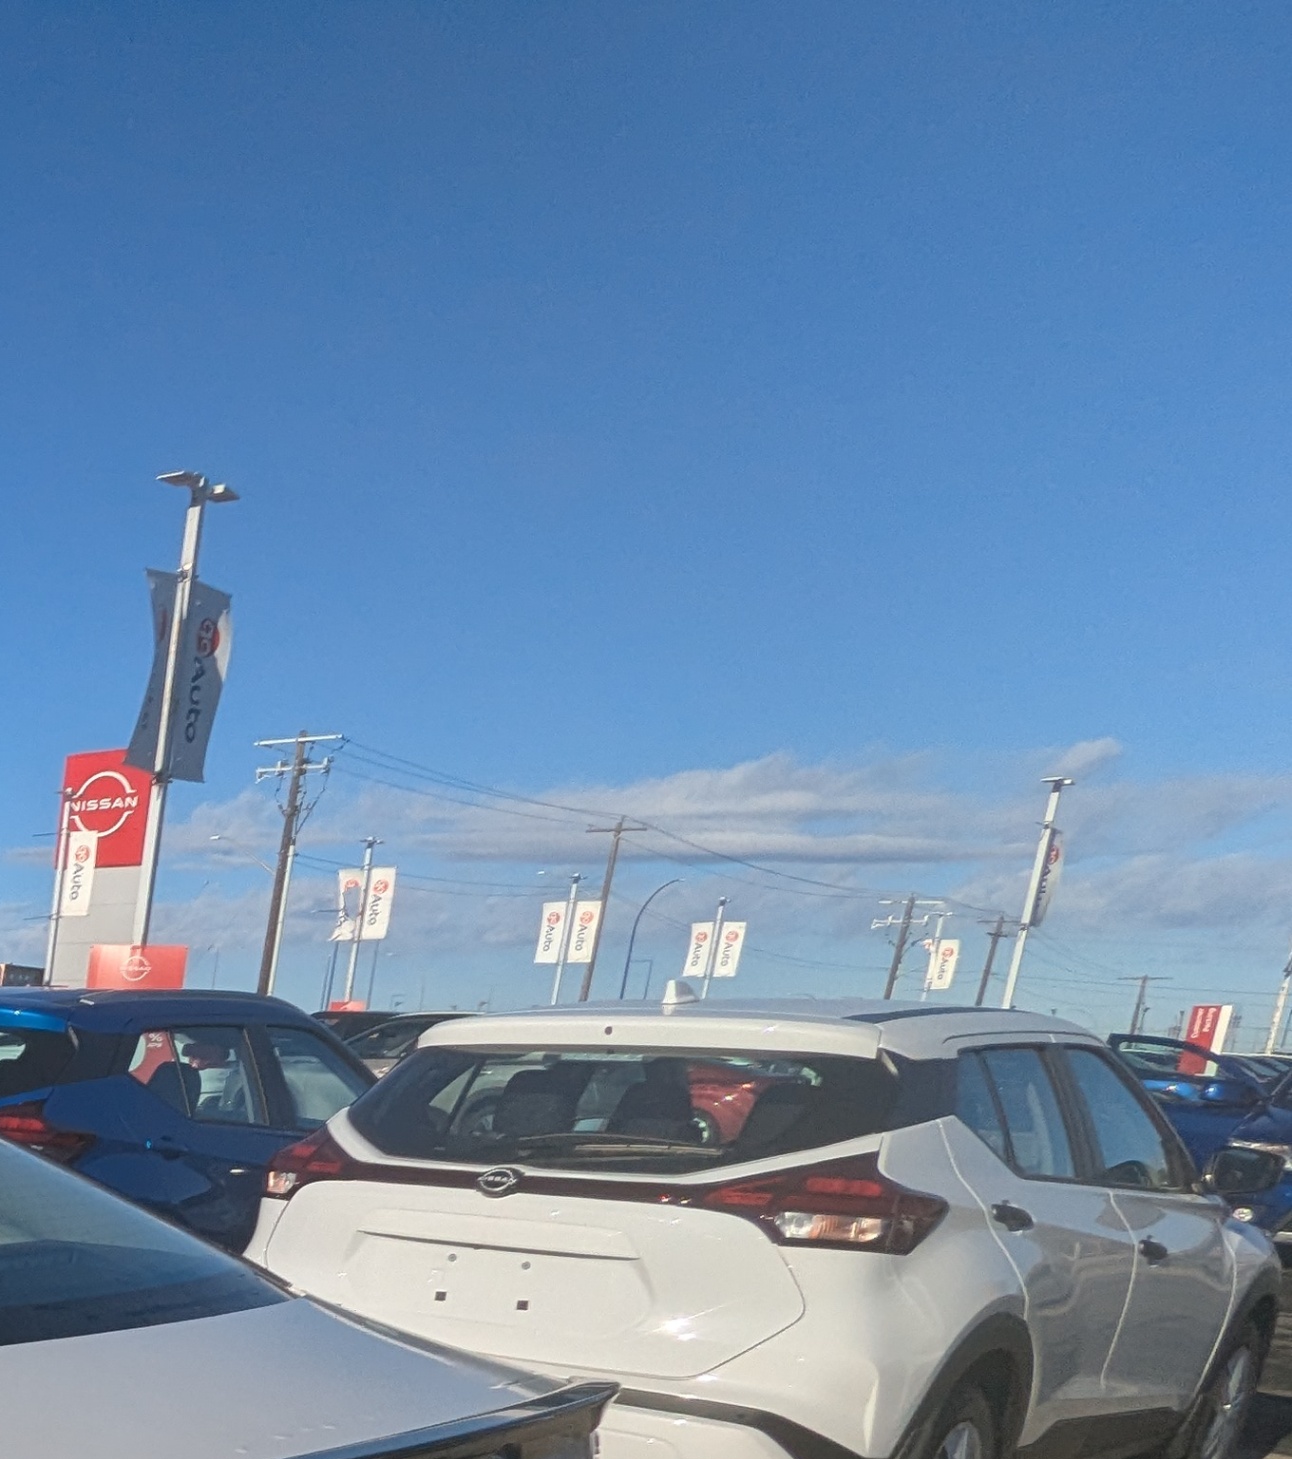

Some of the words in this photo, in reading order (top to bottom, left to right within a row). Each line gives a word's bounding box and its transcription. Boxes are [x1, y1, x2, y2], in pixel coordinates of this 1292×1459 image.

[185, 657, 206, 744] Auto
[70, 796, 138, 812] NISSAN
[69, 863, 86, 901] Auto
[367, 894, 382, 926] Auto
[543, 925, 555, 952] Auto
[575, 924, 588, 951] Auto
[691, 942, 703, 967] Auto
[721, 942, 734, 967] Auto
